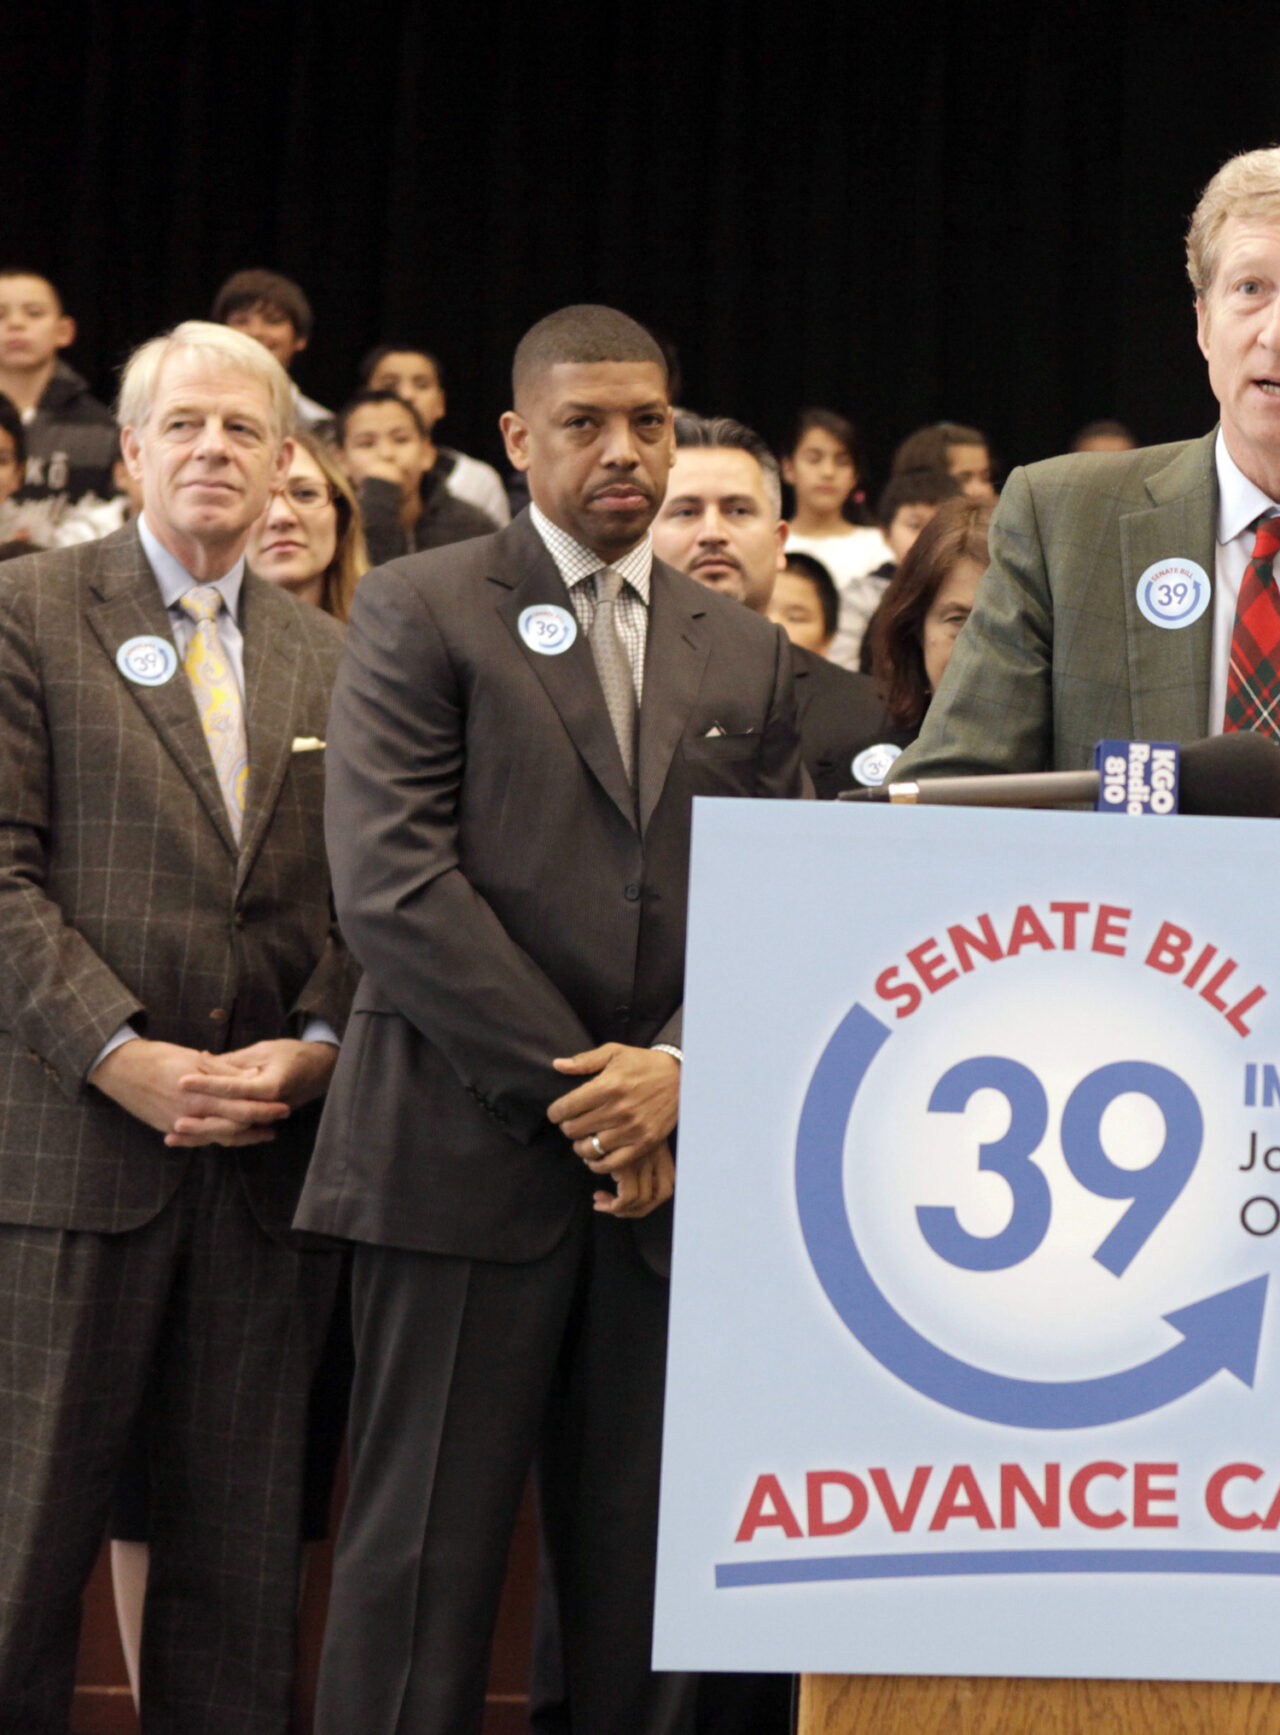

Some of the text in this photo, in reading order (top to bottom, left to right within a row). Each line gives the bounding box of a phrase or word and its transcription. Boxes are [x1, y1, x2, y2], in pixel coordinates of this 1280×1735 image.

[1157, 583, 1188, 606] 39
[133, 652, 157, 671] 39
[535, 620, 559, 639] 39
[1103, 756, 1127, 804] 810
[1126, 743, 1151, 816] Radio
[1150, 749, 1176, 814] KGO
[875, 901, 1268, 1039] SENATE BILL
[914, 1055, 1205, 1279] 39
[734, 1460, 1180, 1543] ADVANCE
